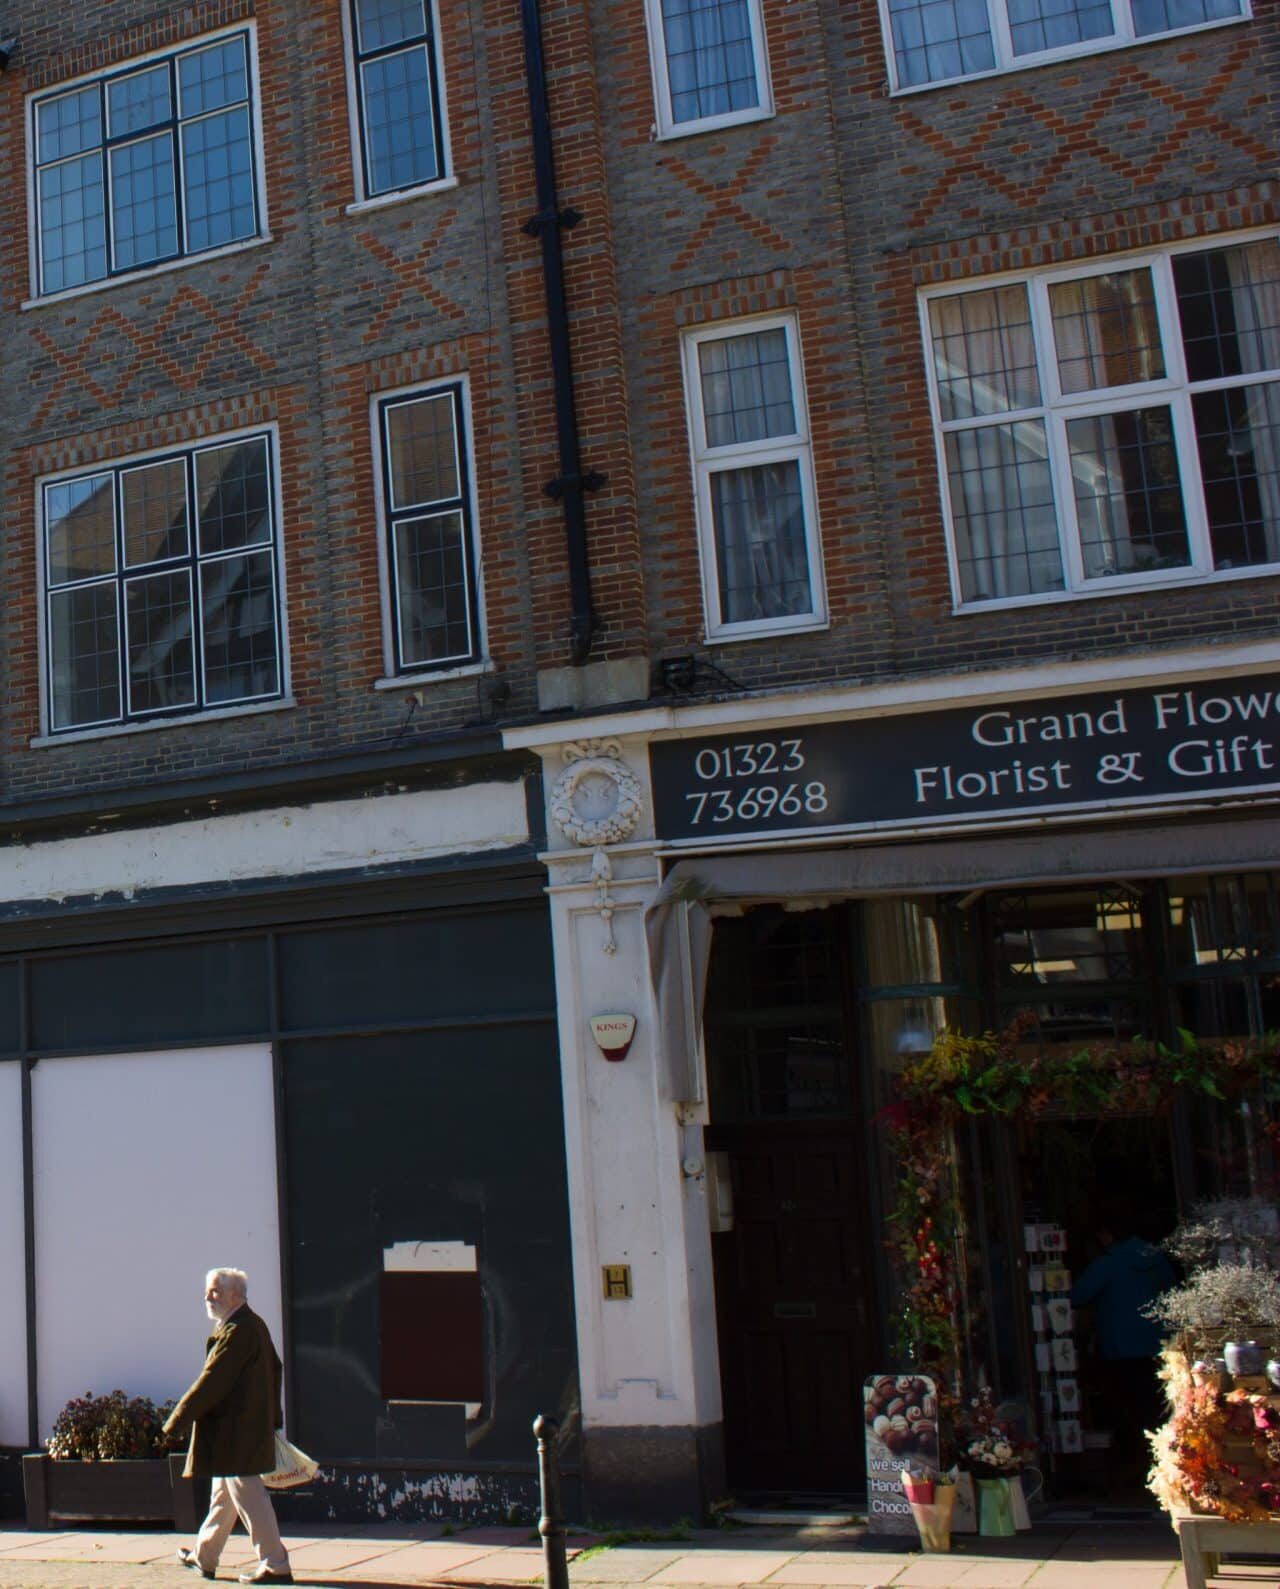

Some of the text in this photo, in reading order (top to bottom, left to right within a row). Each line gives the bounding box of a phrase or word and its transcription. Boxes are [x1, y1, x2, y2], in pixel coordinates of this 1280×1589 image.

[972, 699, 1128, 747] Grand
[695, 739, 805, 780] 01323
[913, 736, 1274, 803] Florist & Gift
[685, 781, 829, 825] 736968
[596, 1023, 628, 1031] KINGS
[871, 1459, 911, 1472] we sell
